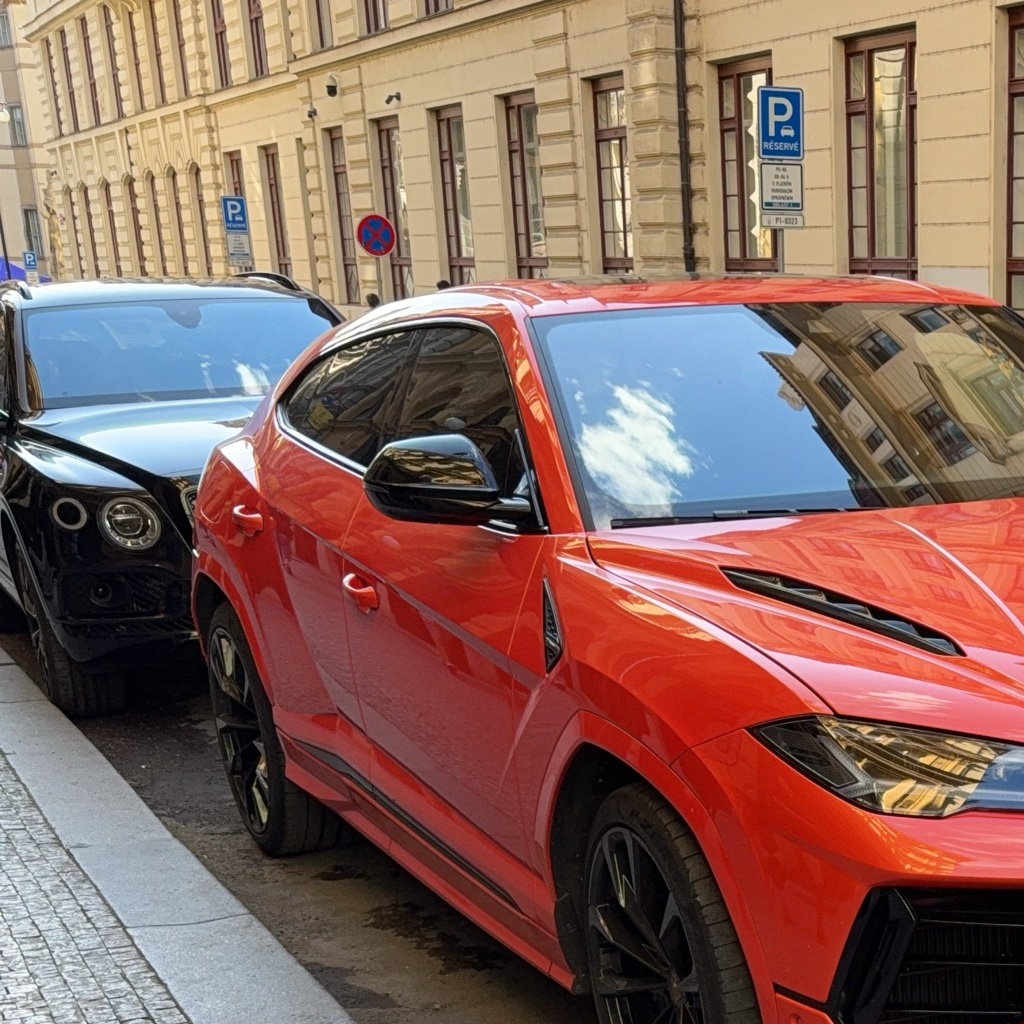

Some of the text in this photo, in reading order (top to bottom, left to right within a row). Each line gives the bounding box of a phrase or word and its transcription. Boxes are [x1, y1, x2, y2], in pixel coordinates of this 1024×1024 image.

[768, 96, 793, 137] P
[763, 140, 799, 151] RÉSERVÉ
[226, 200, 241, 221] P
[25, 253, 34, 265] P
